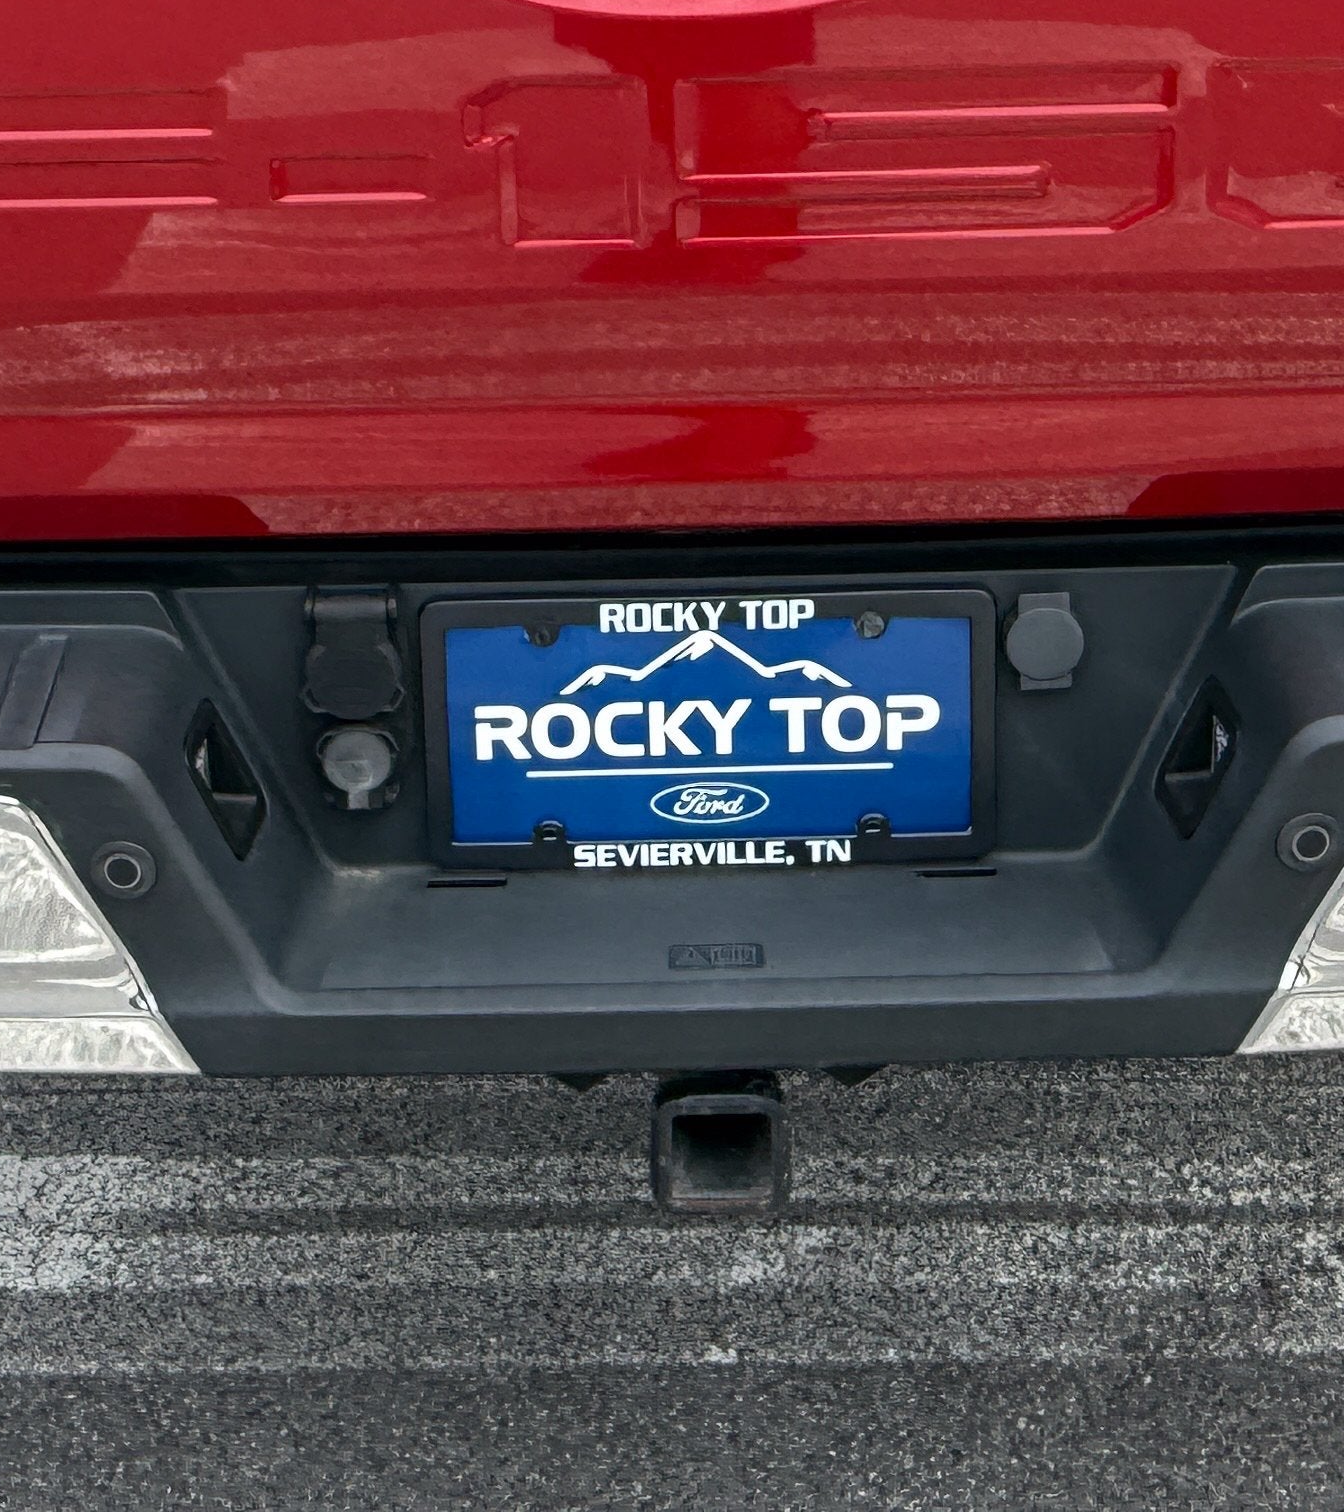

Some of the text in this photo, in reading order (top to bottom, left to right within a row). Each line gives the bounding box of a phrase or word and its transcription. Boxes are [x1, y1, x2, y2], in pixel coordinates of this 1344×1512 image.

[599, 598, 815, 633] ROCKY TOP
[474, 694, 941, 762] ROCKY TOP
[673, 787, 746, 816] Ford
[573, 838, 852, 868] SEVIERVILLE, TN
